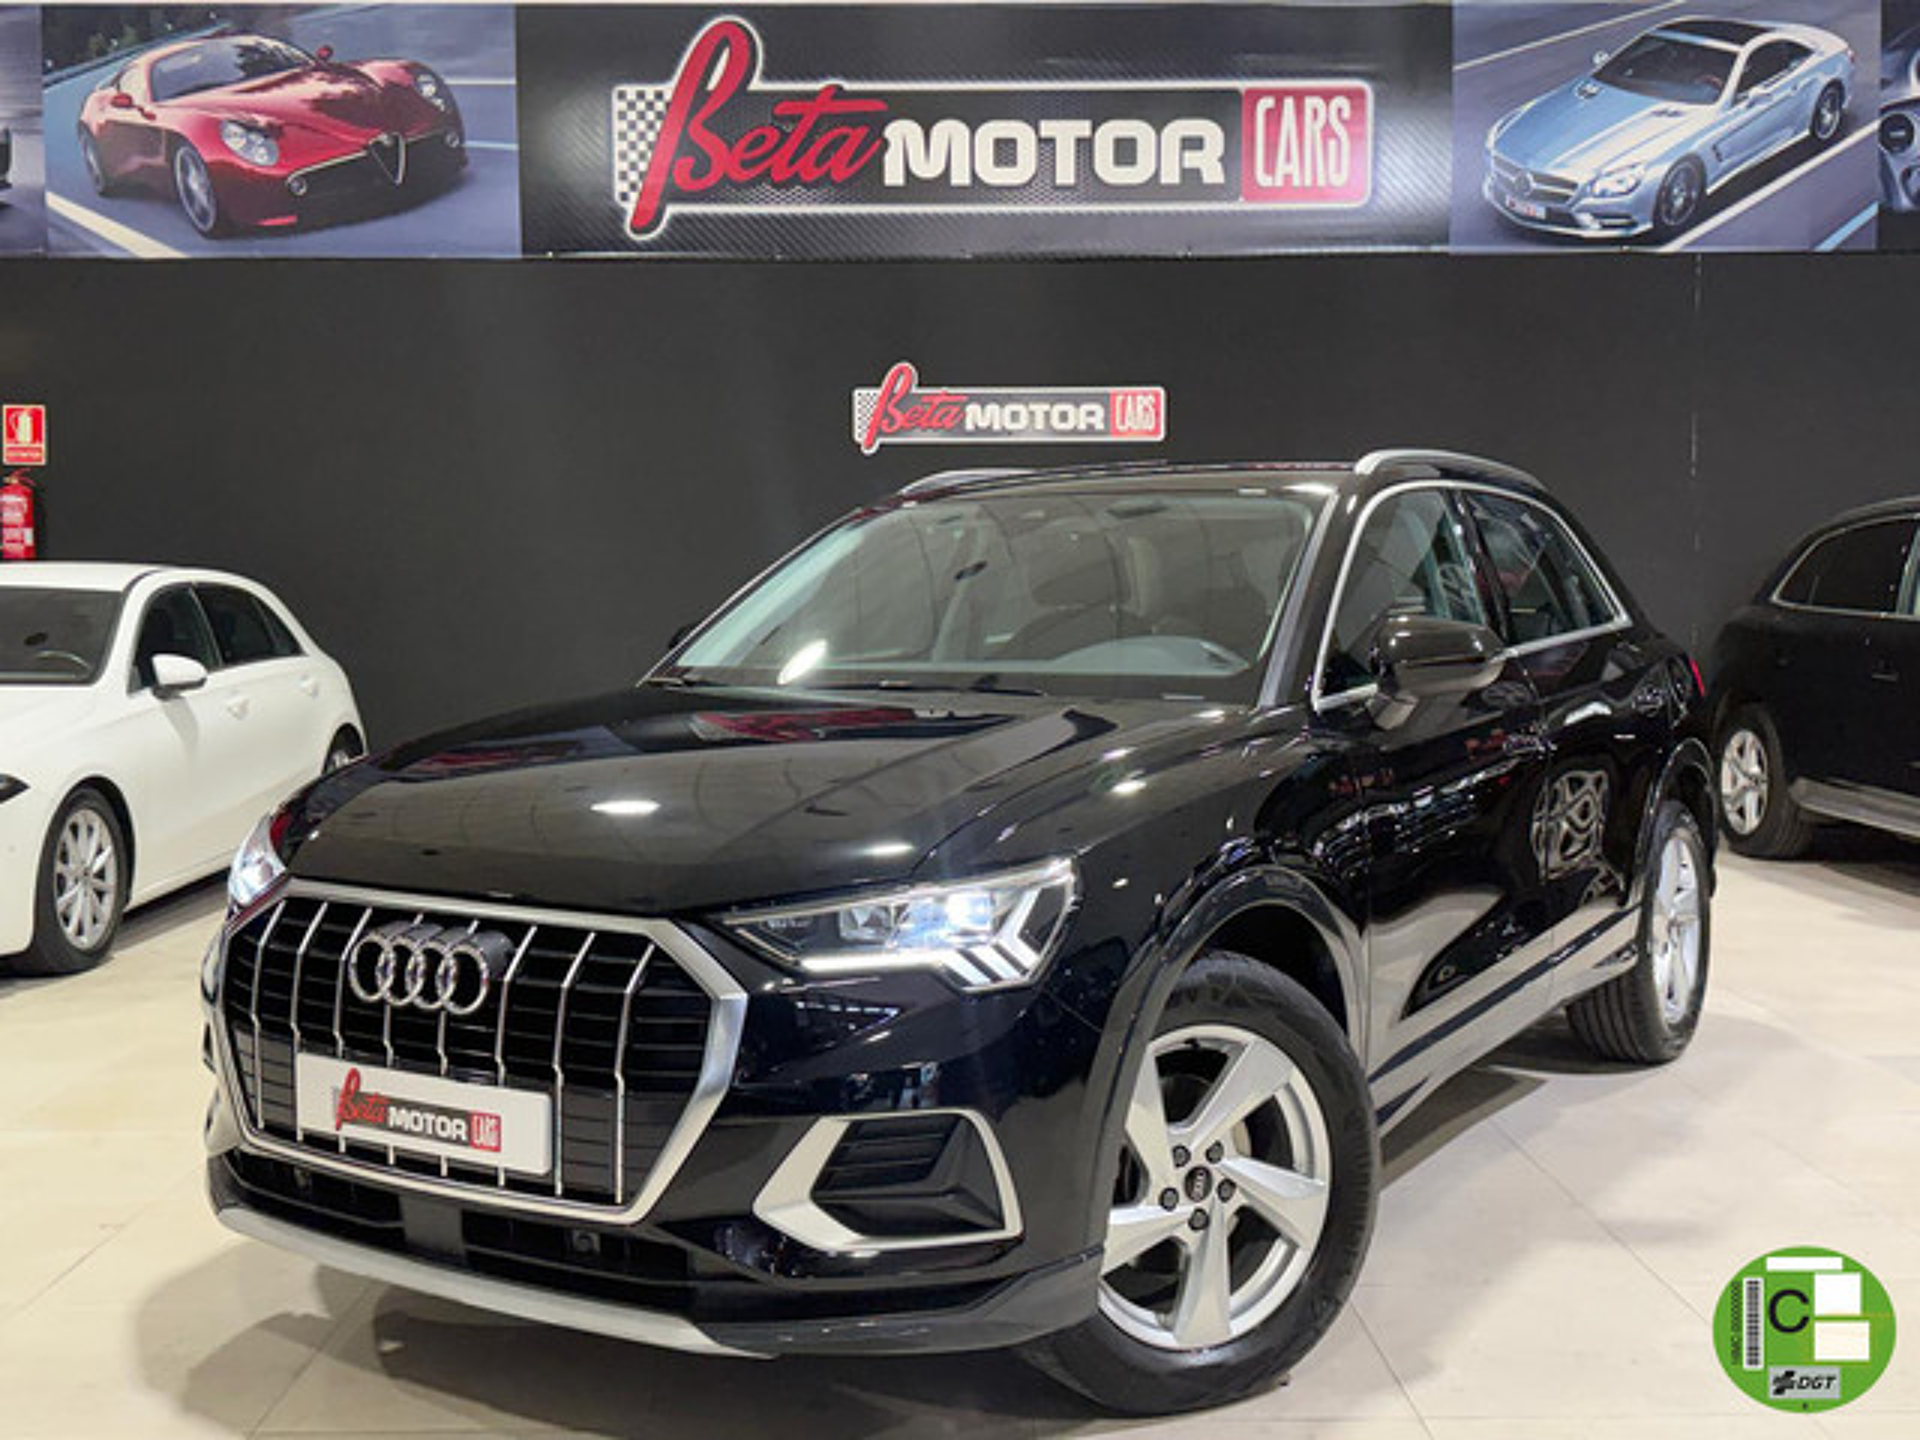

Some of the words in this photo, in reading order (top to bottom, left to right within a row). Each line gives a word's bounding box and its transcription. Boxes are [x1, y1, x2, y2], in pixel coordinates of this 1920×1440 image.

[882, 118, 1225, 186] MOTOR
[1253, 95, 1352, 189] CARS
[965, 402, 1105, 431] MOTOR
[1115, 393, 1156, 432] CARS
[388, 1106, 469, 1142] MOTOR
